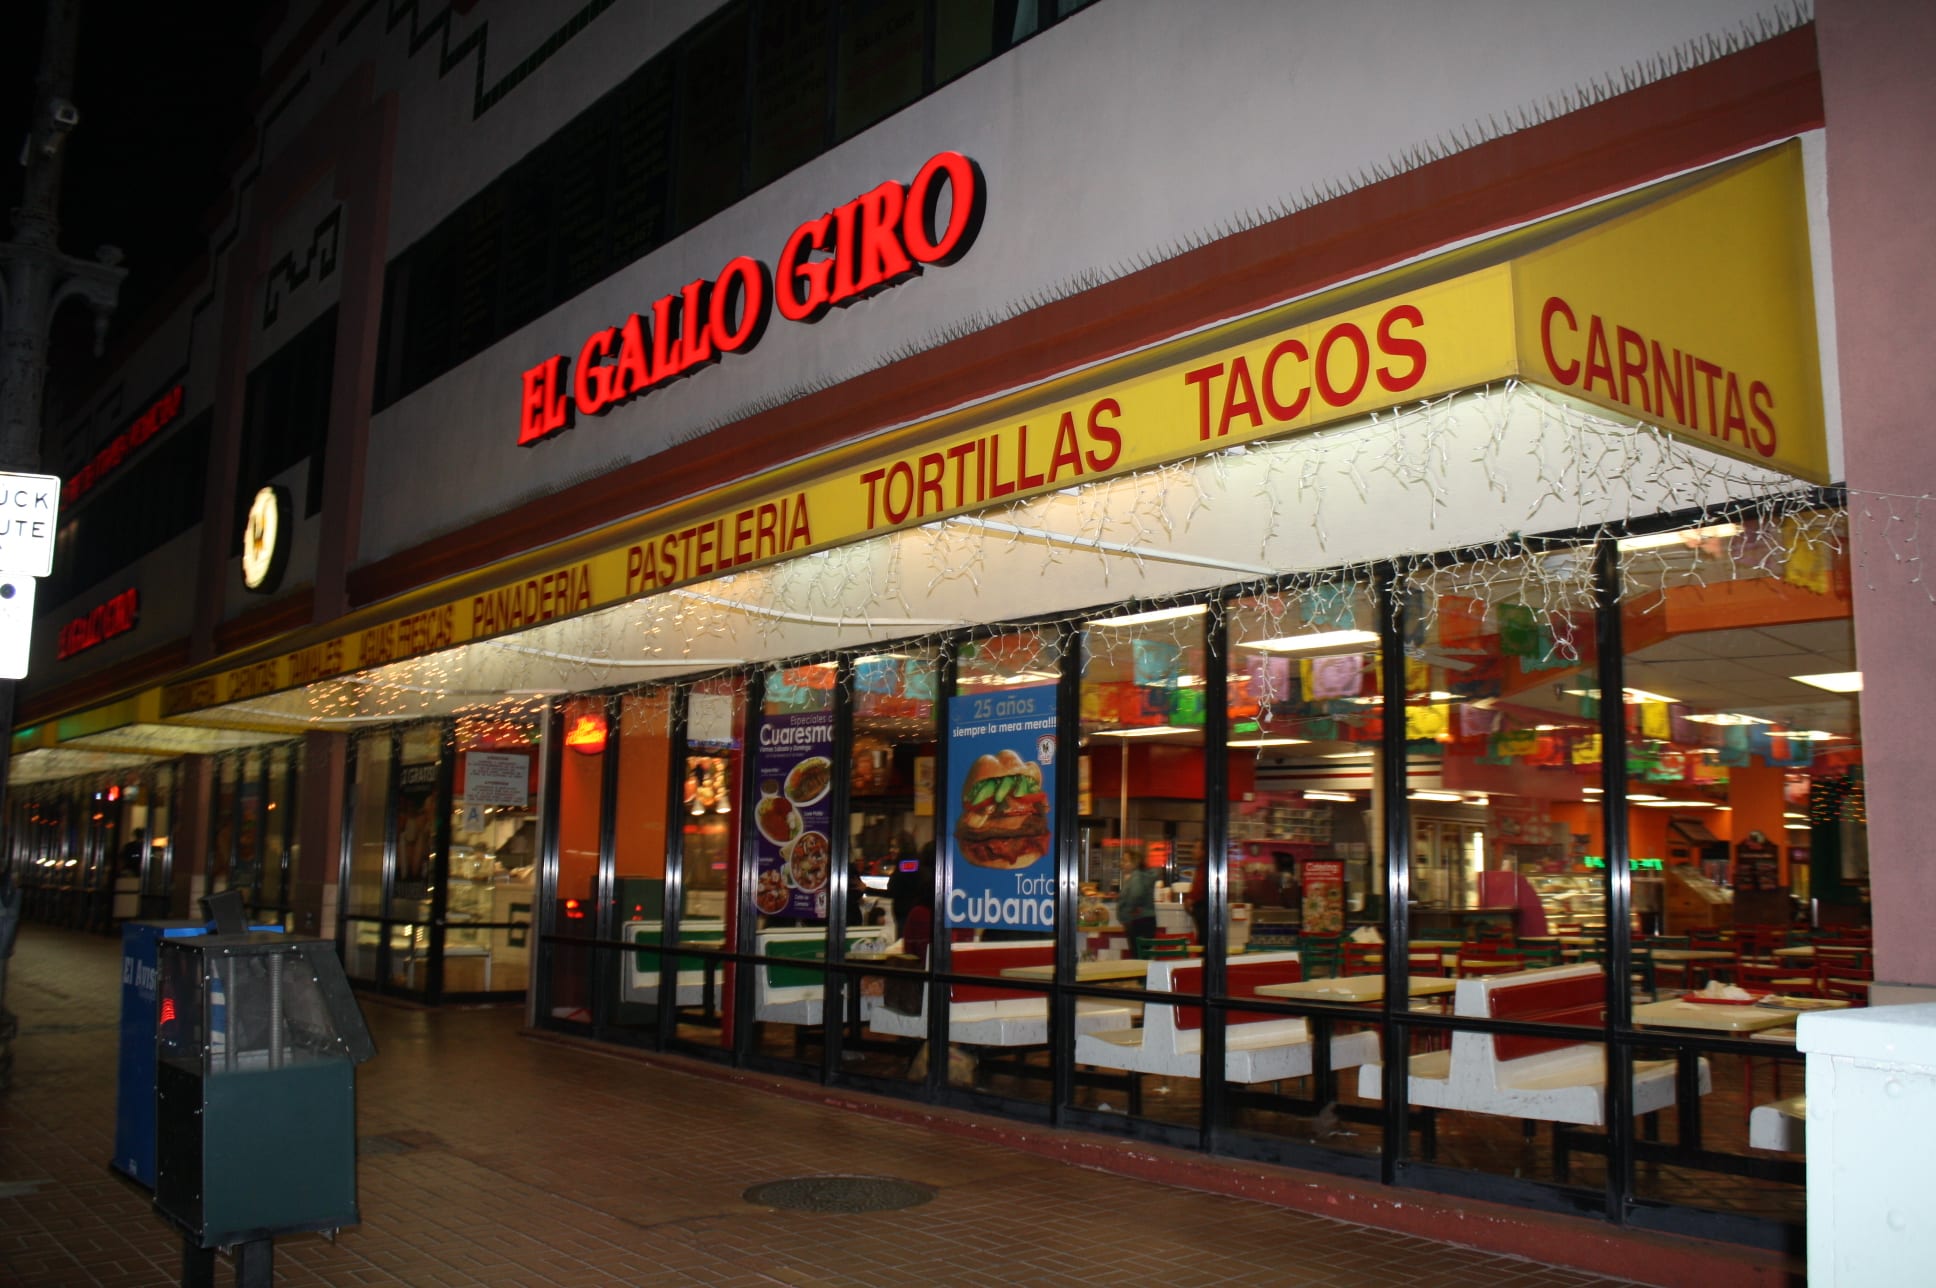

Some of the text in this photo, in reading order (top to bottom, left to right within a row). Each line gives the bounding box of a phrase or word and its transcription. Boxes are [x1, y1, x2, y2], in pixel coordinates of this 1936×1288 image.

[517, 354, 572, 447] EL
[573, 256, 771, 415] GALLO
[775, 151, 986, 322] GIRO
[1185, 304, 1427, 440] TACOS
[1540, 297, 1776, 458] CARNITAS
[860, 398, 1122, 530] TORTILLAS
[625, 493, 813, 594] PASTELERIA
[472, 564, 593, 636] PANADERIA
[952, 716, 1057, 738] siempre la mera mera!!!
[973, 696, 1034, 719] 25 años
[468, 807, 479, 822] A
[948, 888, 1054, 926] Cubana
